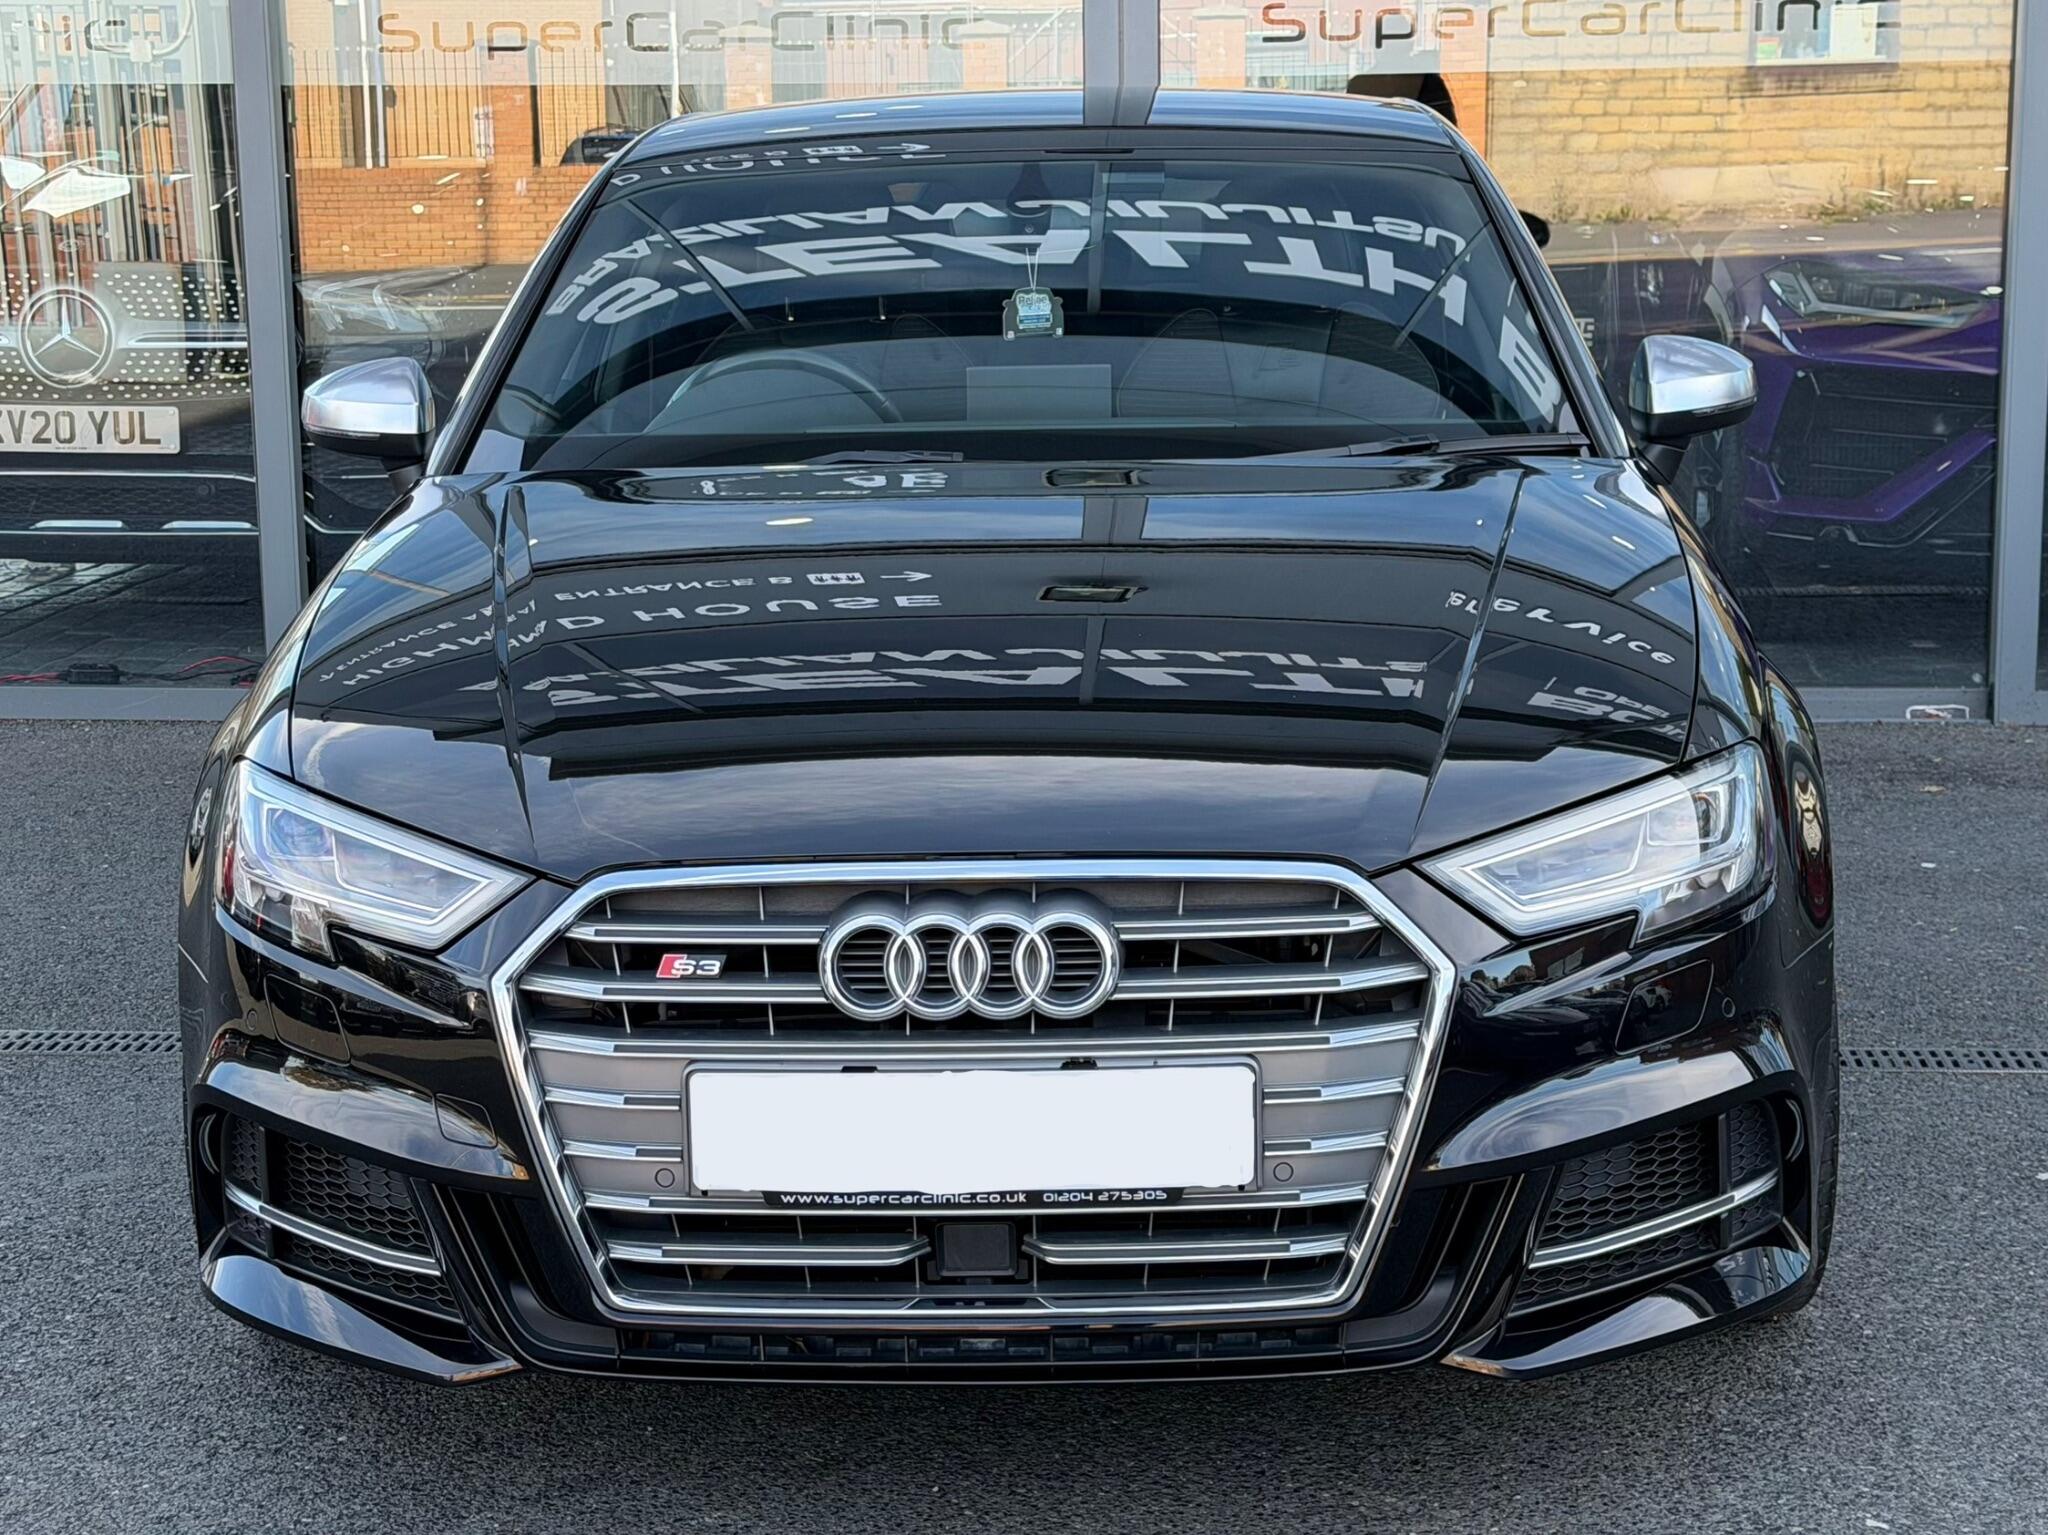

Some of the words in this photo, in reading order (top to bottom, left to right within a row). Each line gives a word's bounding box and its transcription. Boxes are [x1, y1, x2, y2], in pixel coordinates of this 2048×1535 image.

[0, 410, 76, 444] V20
[87, 410, 161, 445] YUL
[671, 959, 721, 976] S3
[780, 1191, 1027, 1206] www.supercarclinic.co.uk
[1042, 1191, 1093, 1203] 01204
[1097, 1189, 1168, 1202] 275305
